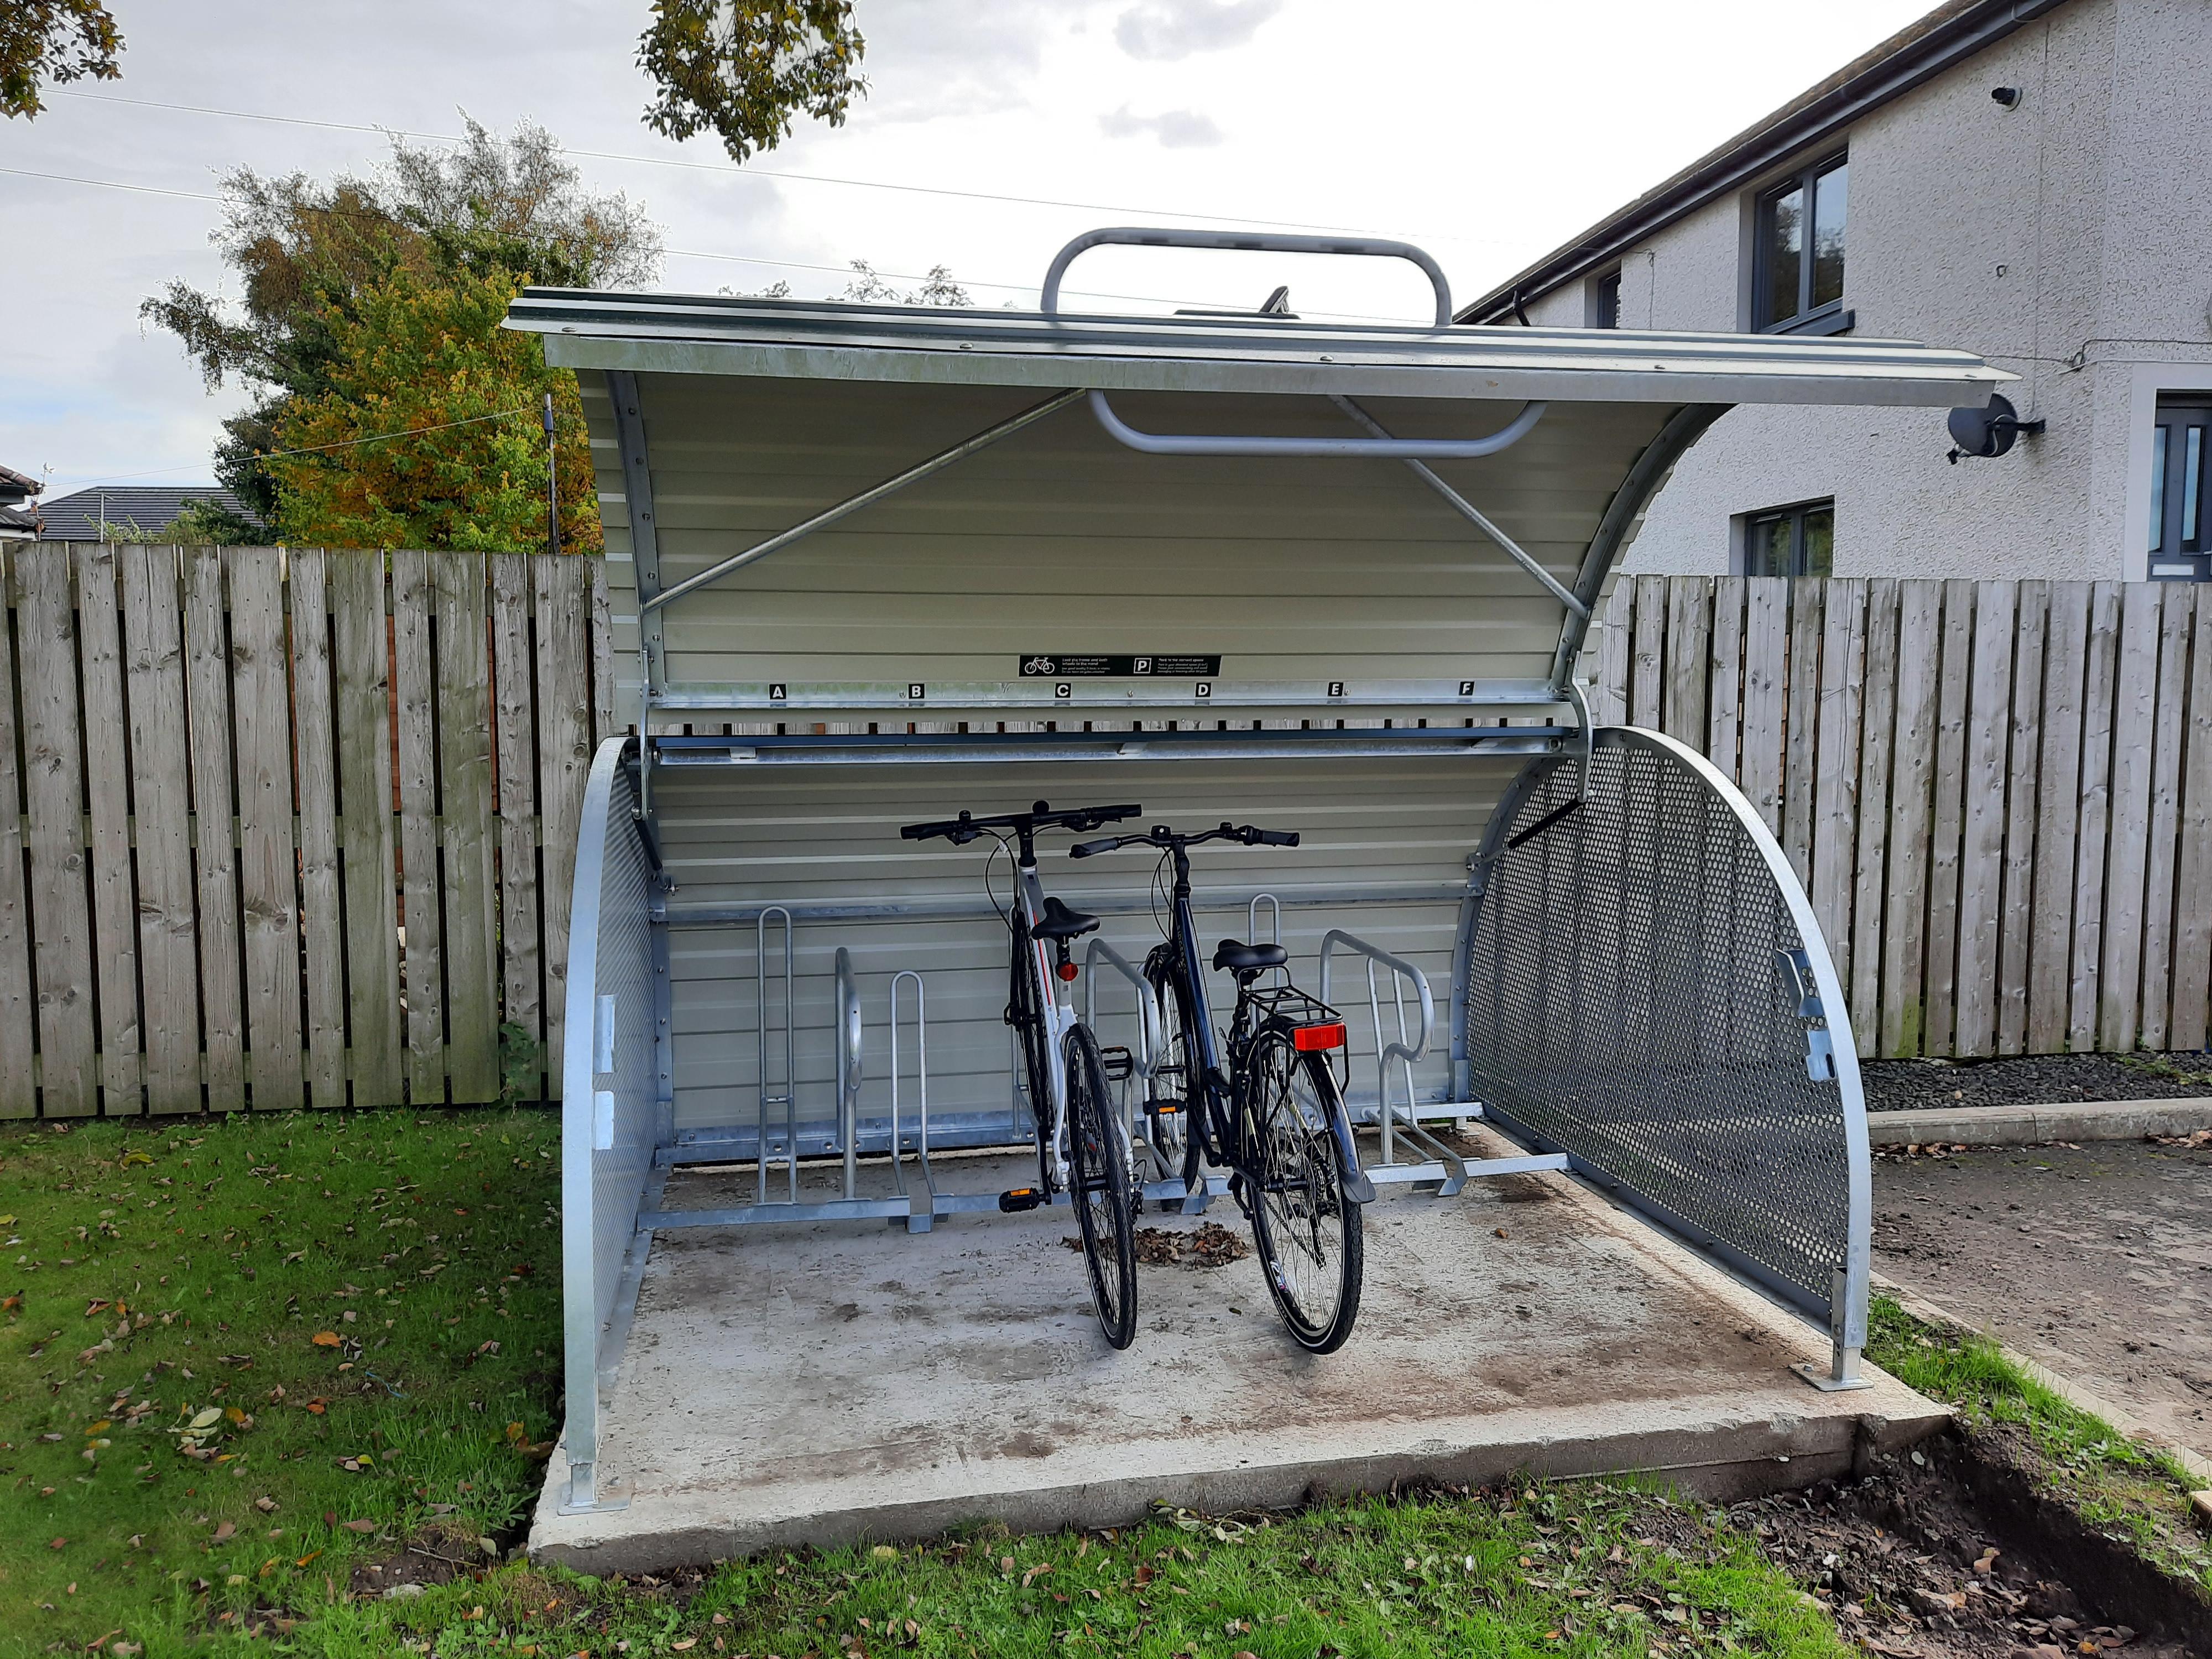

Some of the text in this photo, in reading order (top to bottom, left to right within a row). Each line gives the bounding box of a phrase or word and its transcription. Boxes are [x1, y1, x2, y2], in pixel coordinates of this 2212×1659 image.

[1138, 660, 1147, 671] P
[773, 686, 784, 698] A
[912, 685, 921, 697] B
[1057, 685, 1068, 696] C
[1198, 684, 1208, 696] D
[1331, 684, 1339, 695] E
[1462, 683, 1471, 694] F
